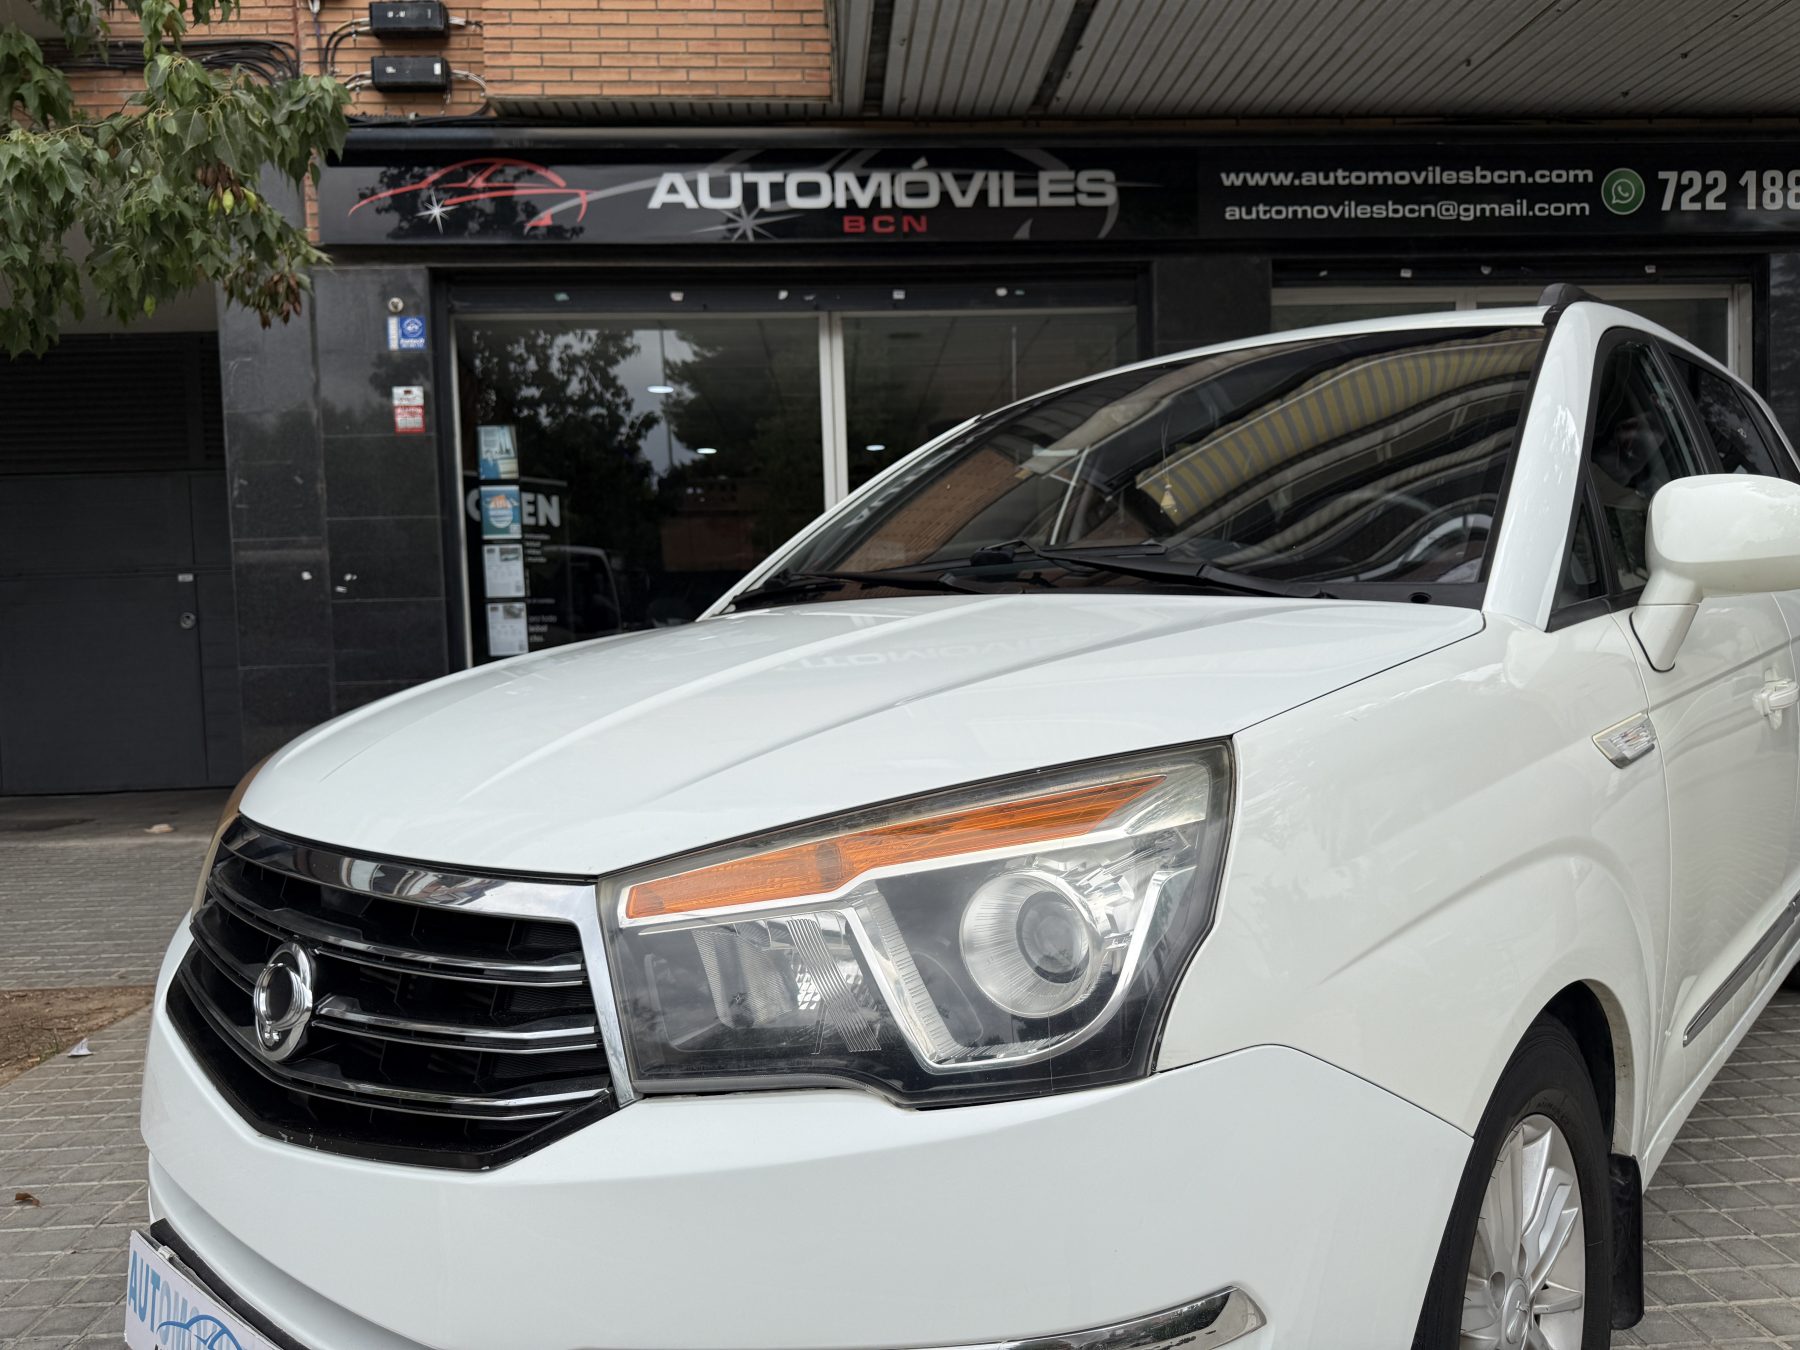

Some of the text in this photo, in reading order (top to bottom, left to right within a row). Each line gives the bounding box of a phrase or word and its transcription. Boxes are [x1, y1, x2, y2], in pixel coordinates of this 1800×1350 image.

[648, 157, 1118, 210] AUTOMÓVILES
[1220, 166, 1593, 187] www.automovilesbcn.com
[1658, 169, 1800, 211] 722 188
[1224, 199, 1590, 222] automovilesbcn@gmail.com
[844, 216, 927, 233] BCN
